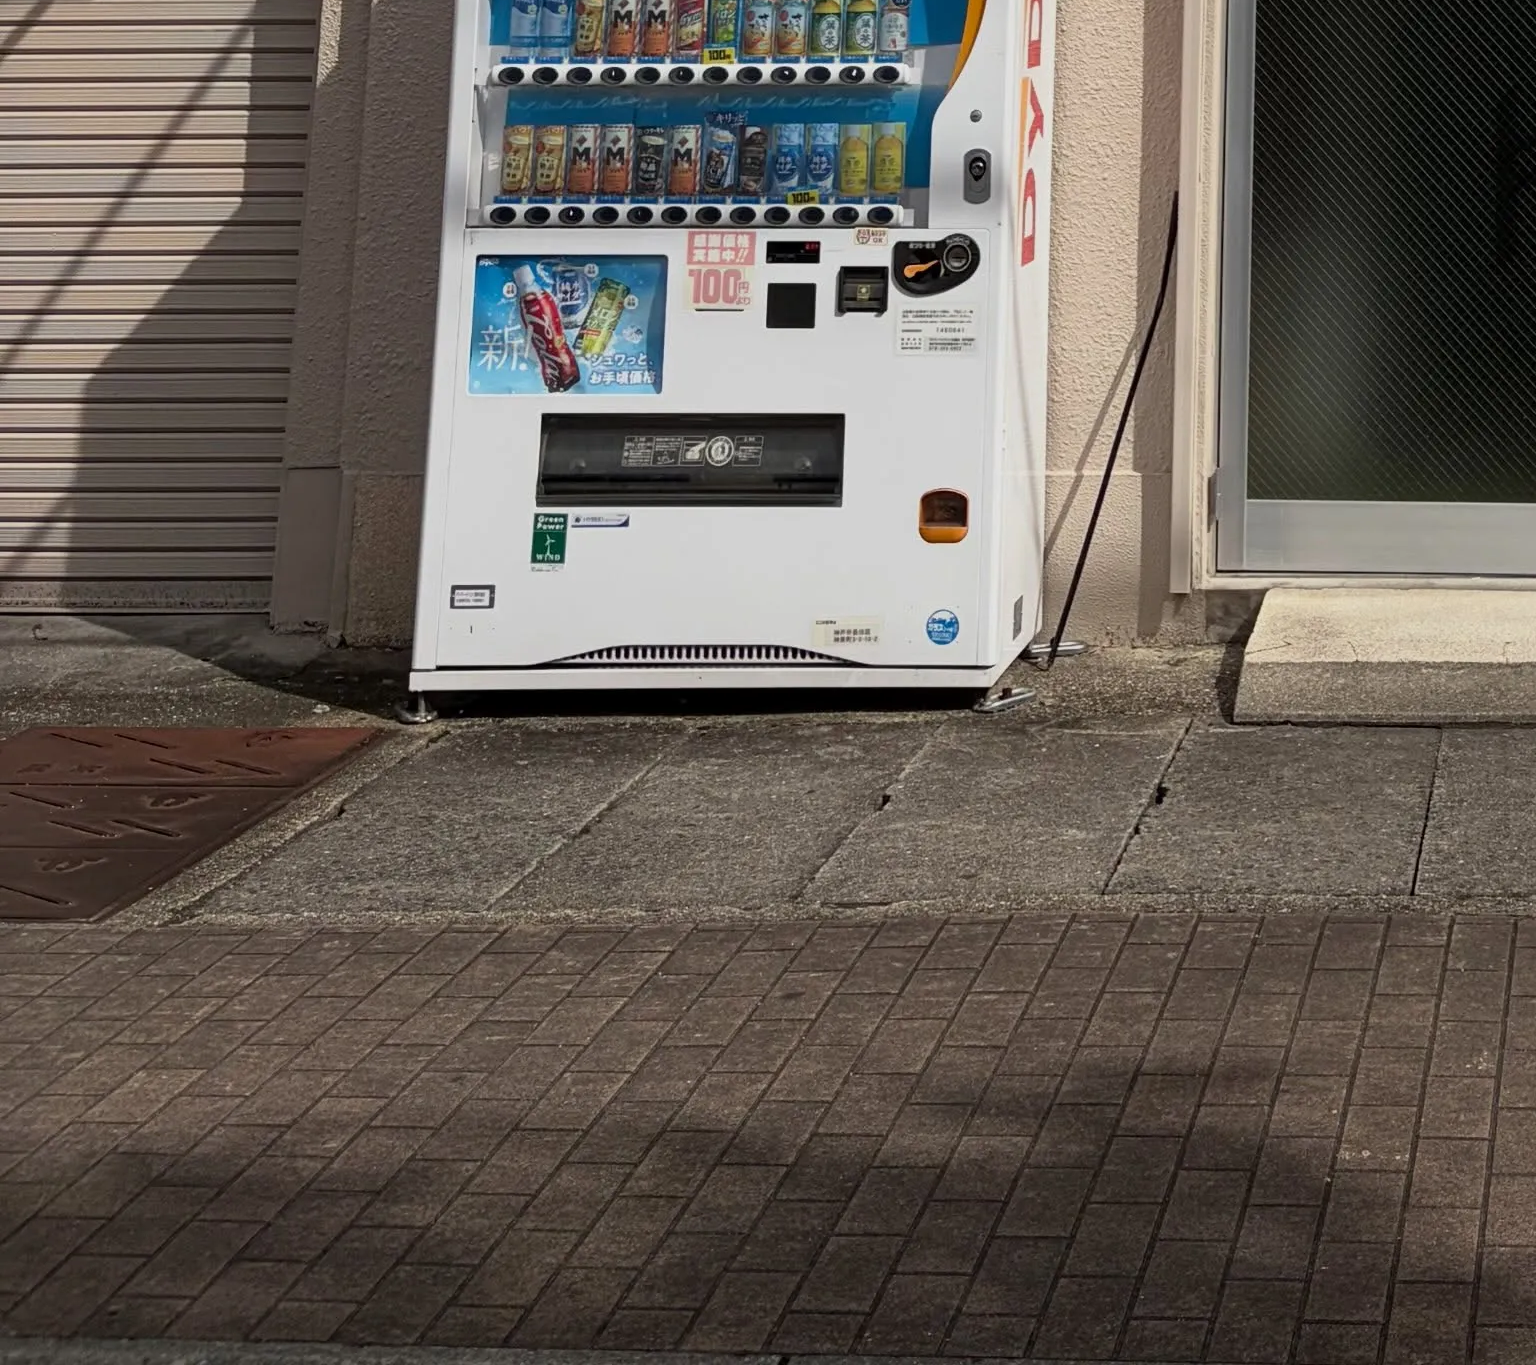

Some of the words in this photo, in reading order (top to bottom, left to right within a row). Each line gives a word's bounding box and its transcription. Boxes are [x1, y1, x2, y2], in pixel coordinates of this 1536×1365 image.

[538, 515, 564, 523] Green
[536, 523, 565, 531] Power
[536, 553, 561, 561] WIND
